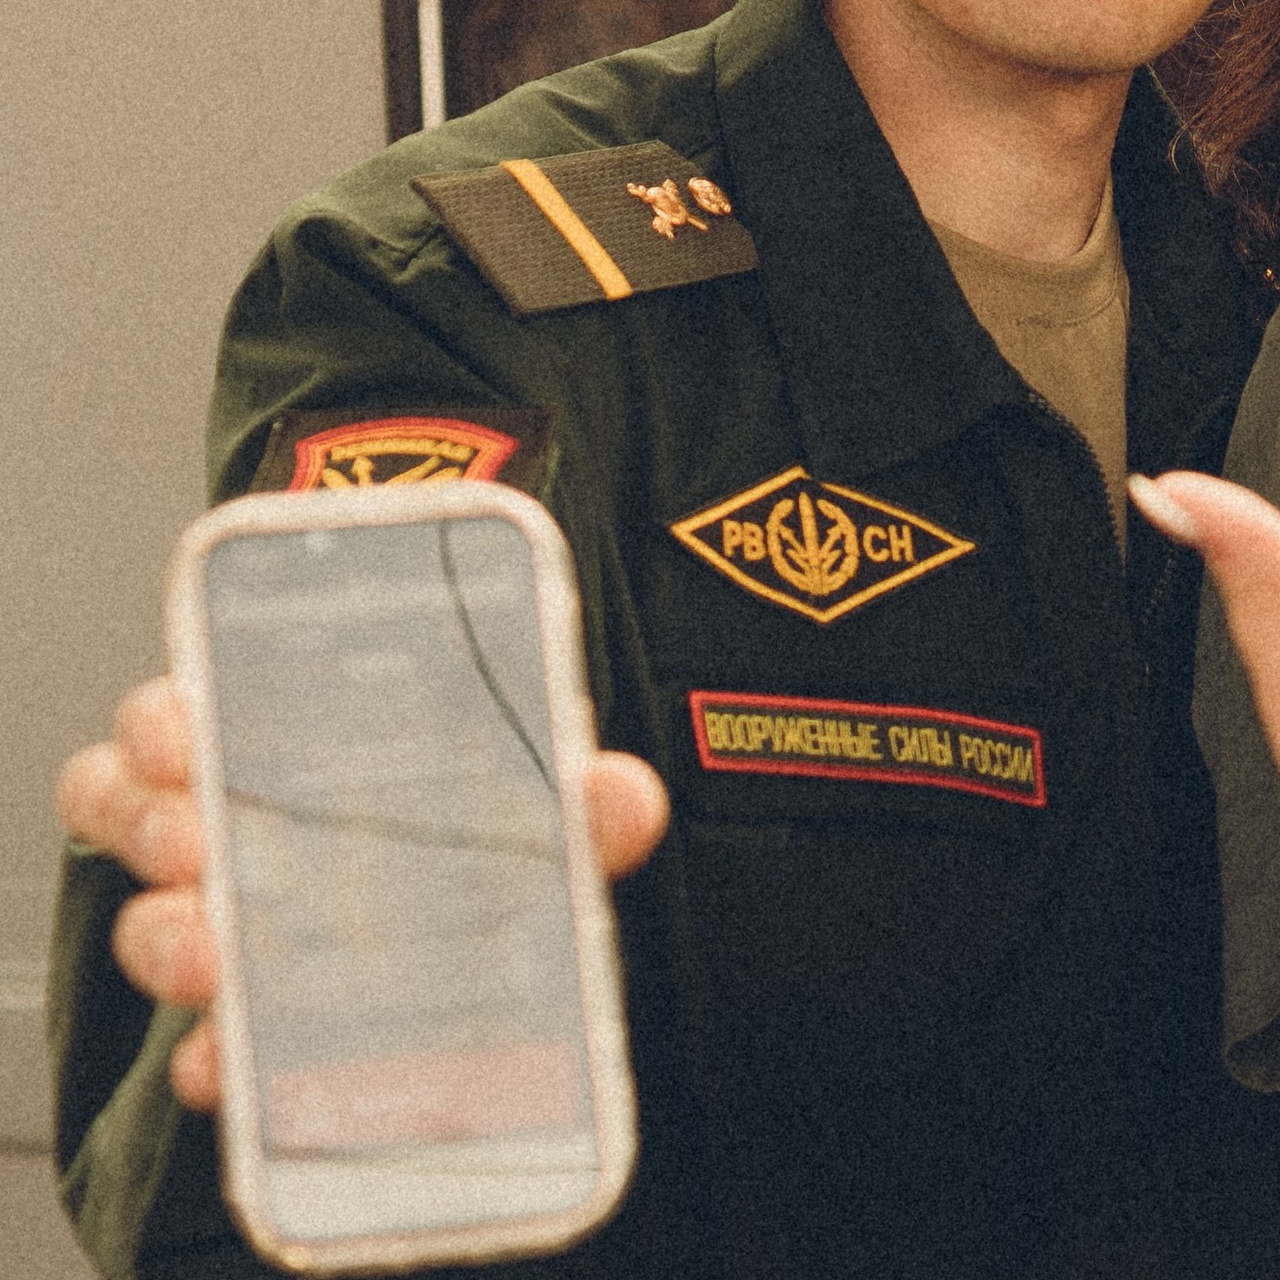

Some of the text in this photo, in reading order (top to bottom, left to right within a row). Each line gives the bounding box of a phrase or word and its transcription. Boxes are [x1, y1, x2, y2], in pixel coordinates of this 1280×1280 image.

[722, 519, 914, 563] РВ СН
[704, 712, 1034, 783] ВООРУЖЕННЫЕ СИЛЫ РОССИИ
